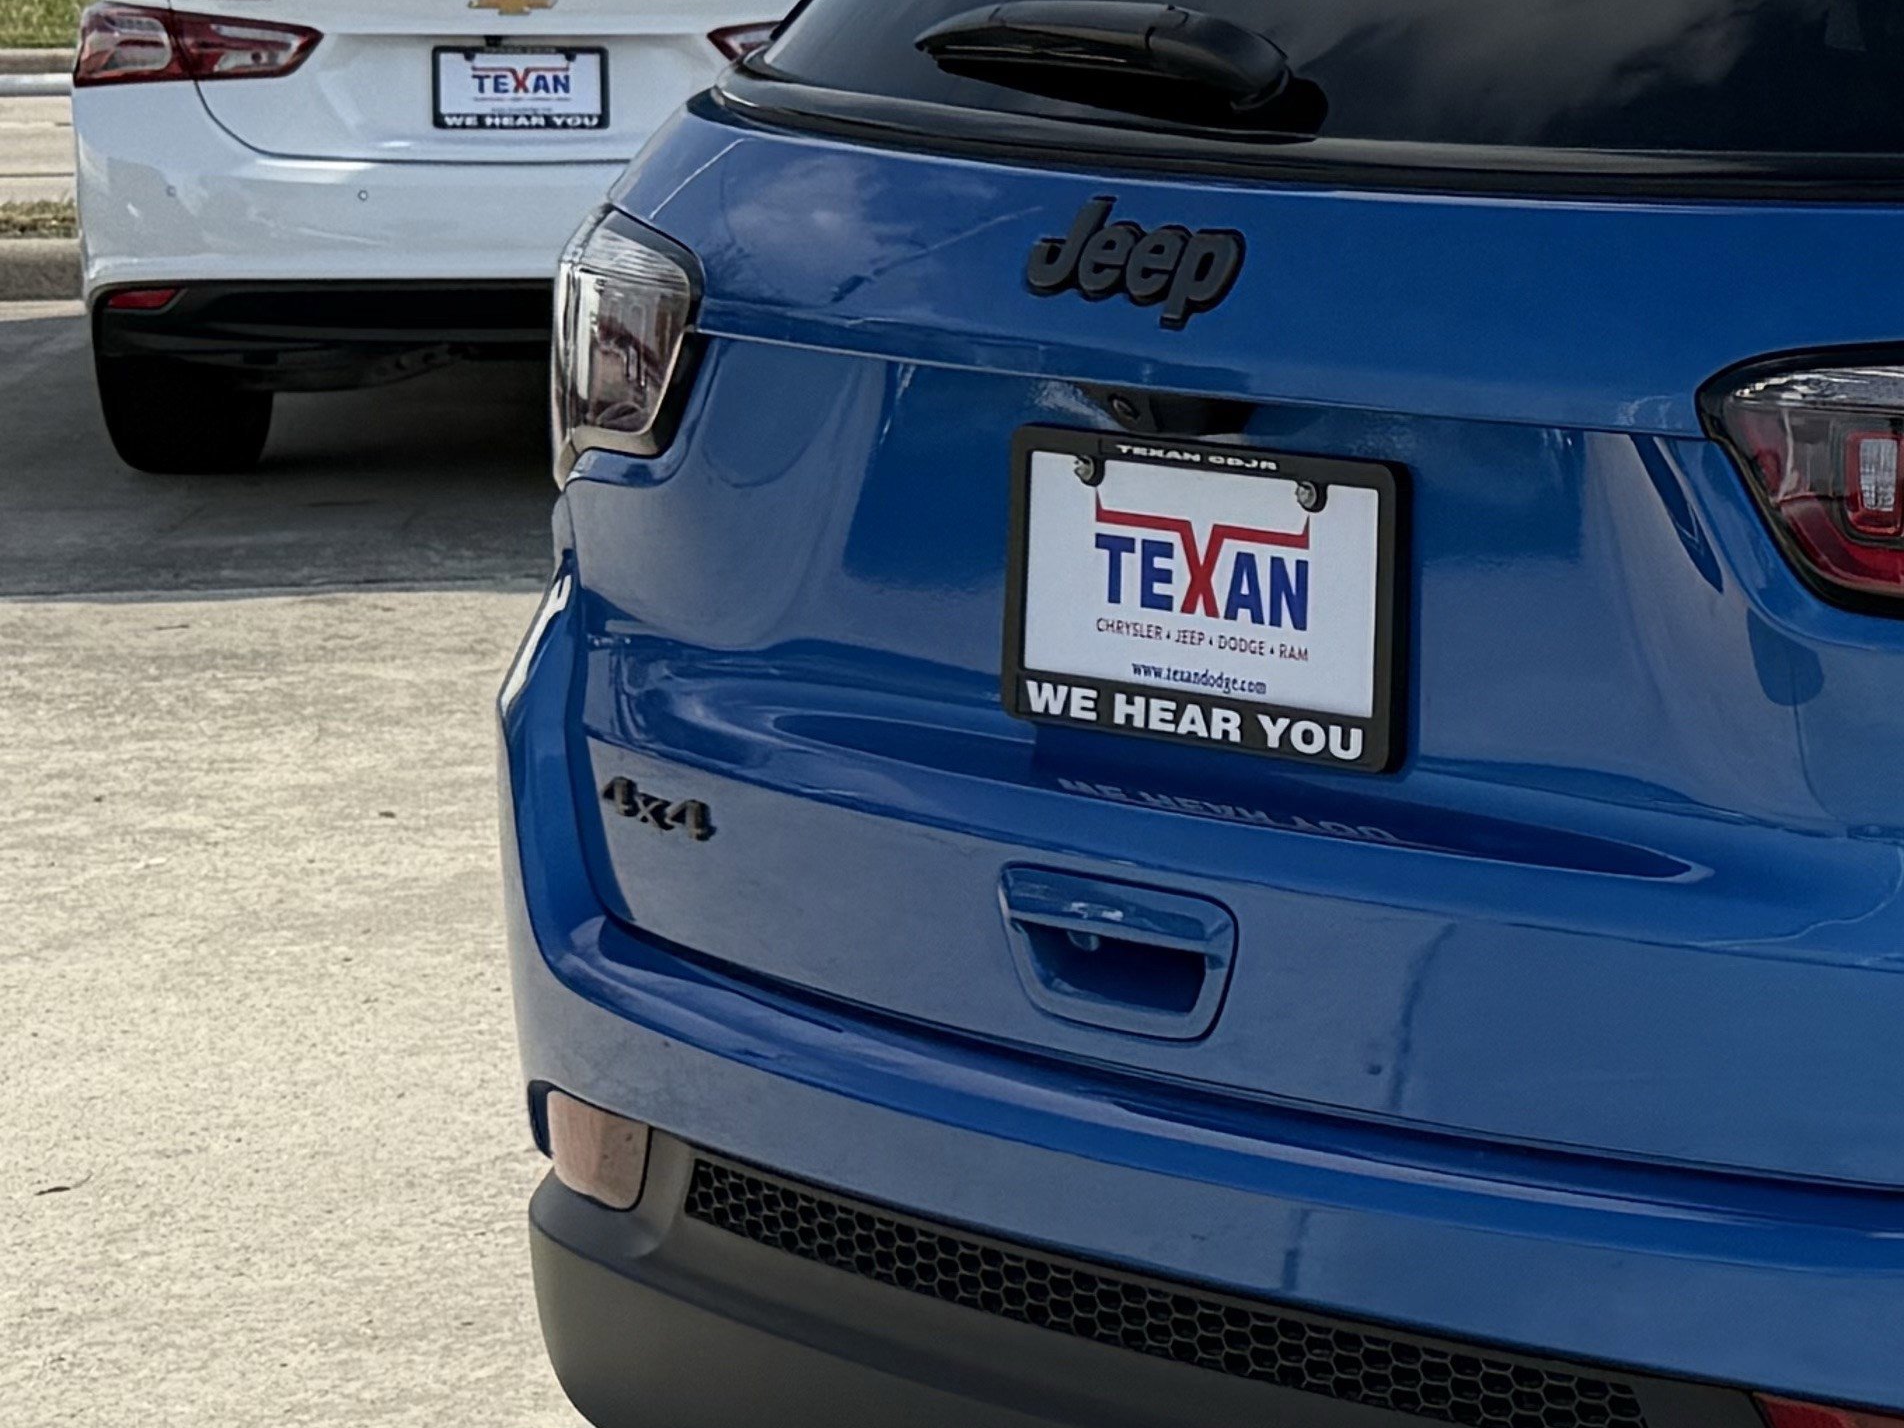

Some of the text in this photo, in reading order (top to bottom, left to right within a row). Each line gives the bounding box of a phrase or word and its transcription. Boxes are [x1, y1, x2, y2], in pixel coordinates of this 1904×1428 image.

[471, 69, 571, 94] TEXAN
[444, 116, 599, 127] WE HEAR YOU
[1026, 195, 1246, 331] Jeep
[1116, 444, 1201, 463] TEXAN
[1095, 520, 1309, 631] TEXAN
[1096, 617, 1309, 662] CHRYSLER JEEP DODGE RAM
[1131, 662, 1268, 695] www.texandodge.com
[1025, 680, 1364, 761] WE HEAR YOU
